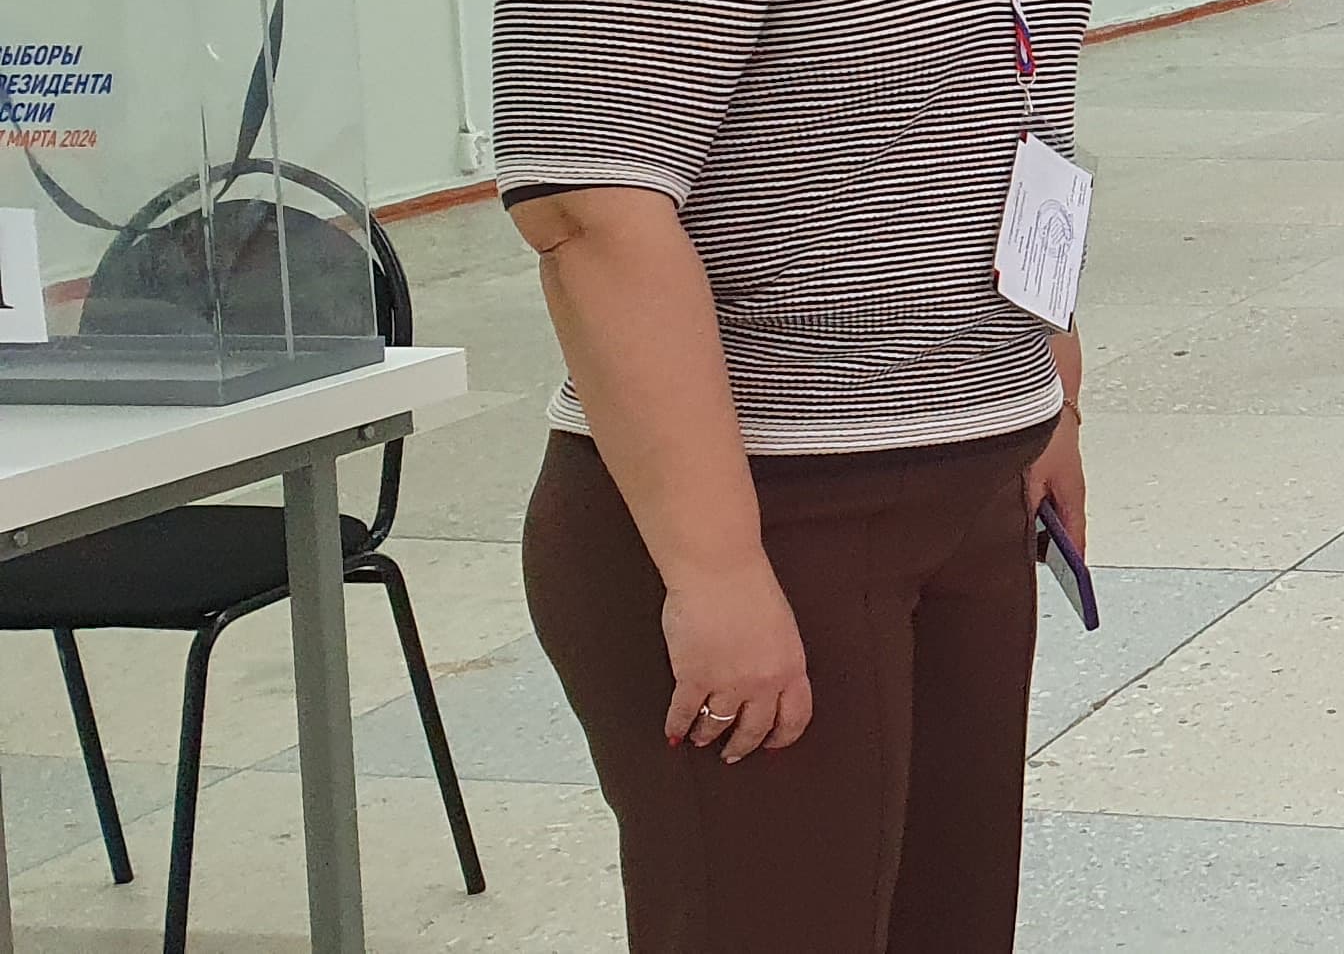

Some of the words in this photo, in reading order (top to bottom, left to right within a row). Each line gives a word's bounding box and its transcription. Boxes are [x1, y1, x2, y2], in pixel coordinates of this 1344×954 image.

[0, 44, 83, 66] ЫБОРЫ
[7, 129, 57, 147] МАРТА
[59, 129, 97, 148] 2024
